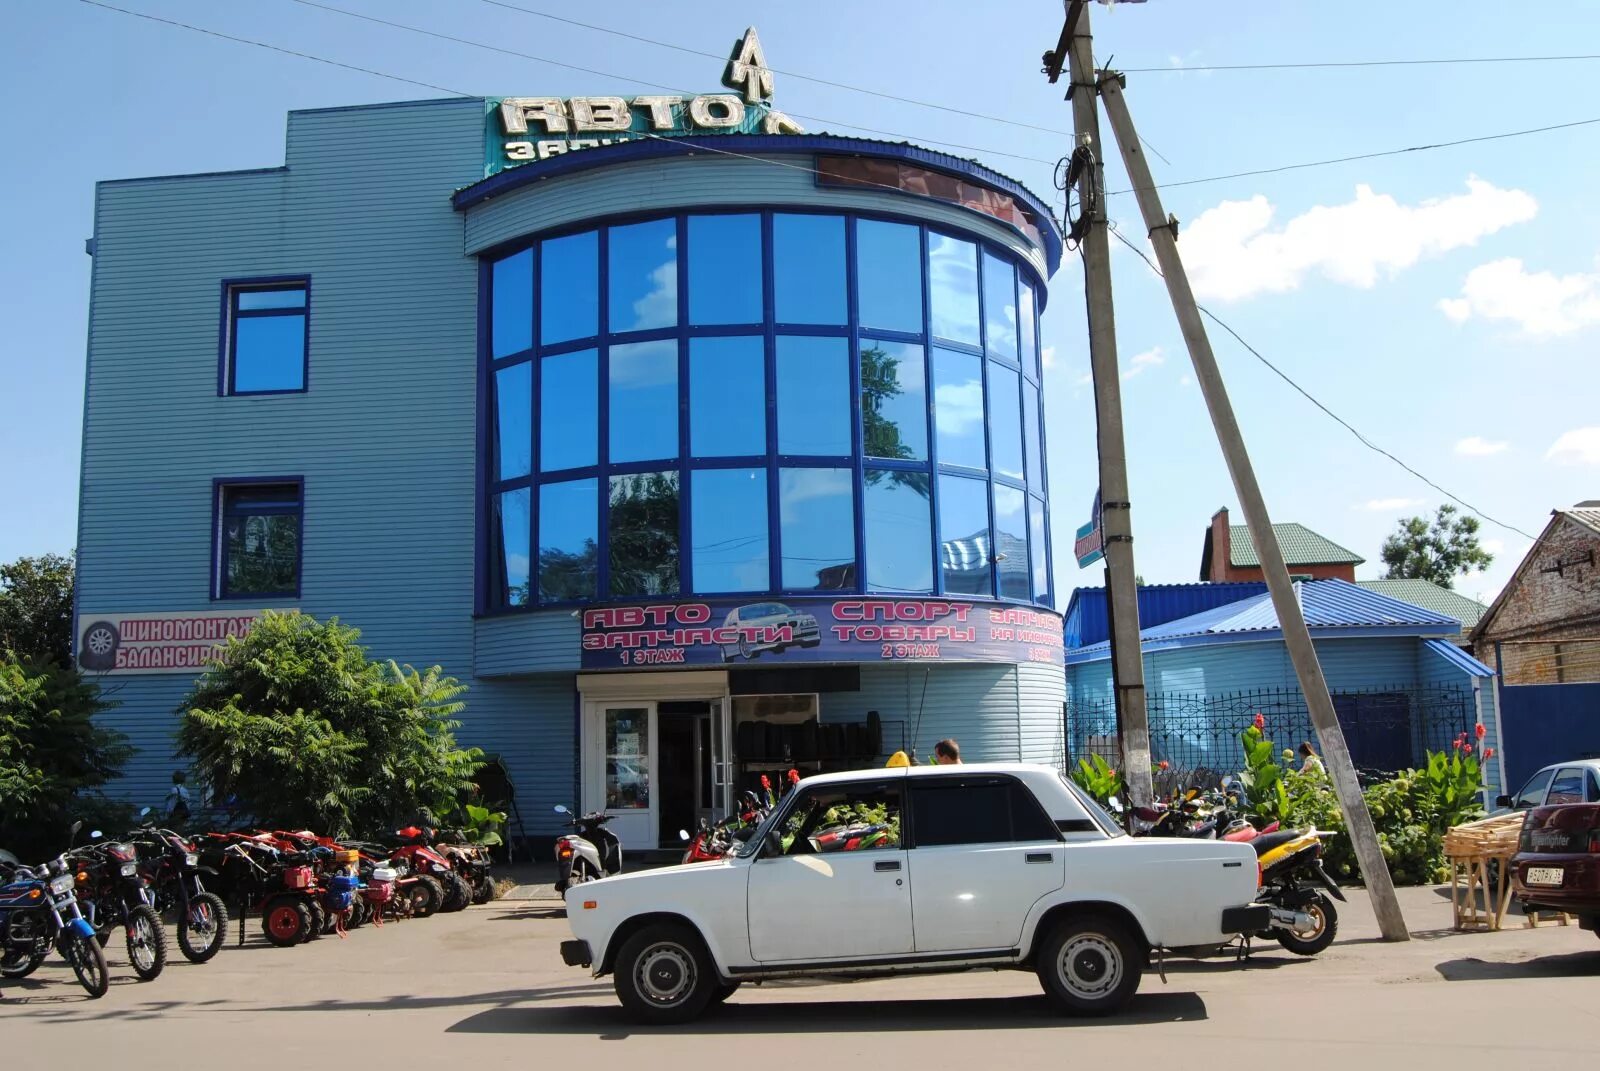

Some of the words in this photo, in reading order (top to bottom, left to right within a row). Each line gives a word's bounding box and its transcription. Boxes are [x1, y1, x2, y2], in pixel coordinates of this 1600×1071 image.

[501, 95, 745, 134] АВТО
[584, 603, 711, 628] АВТО
[832, 601, 974, 622] СПОРТ
[119, 617, 256, 641] ШИНОМОНТАЖ
[582, 625, 793, 650] ЗАПЧАСТИ
[831, 625, 976, 641] ТОВАРЫ
[991, 628, 1015, 641] НА
[620, 651, 630, 665] 1
[634, 649, 685, 665] ЭТАЖ
[881, 644, 893, 658] 2
[896, 643, 940, 658] ЭТАЖ
